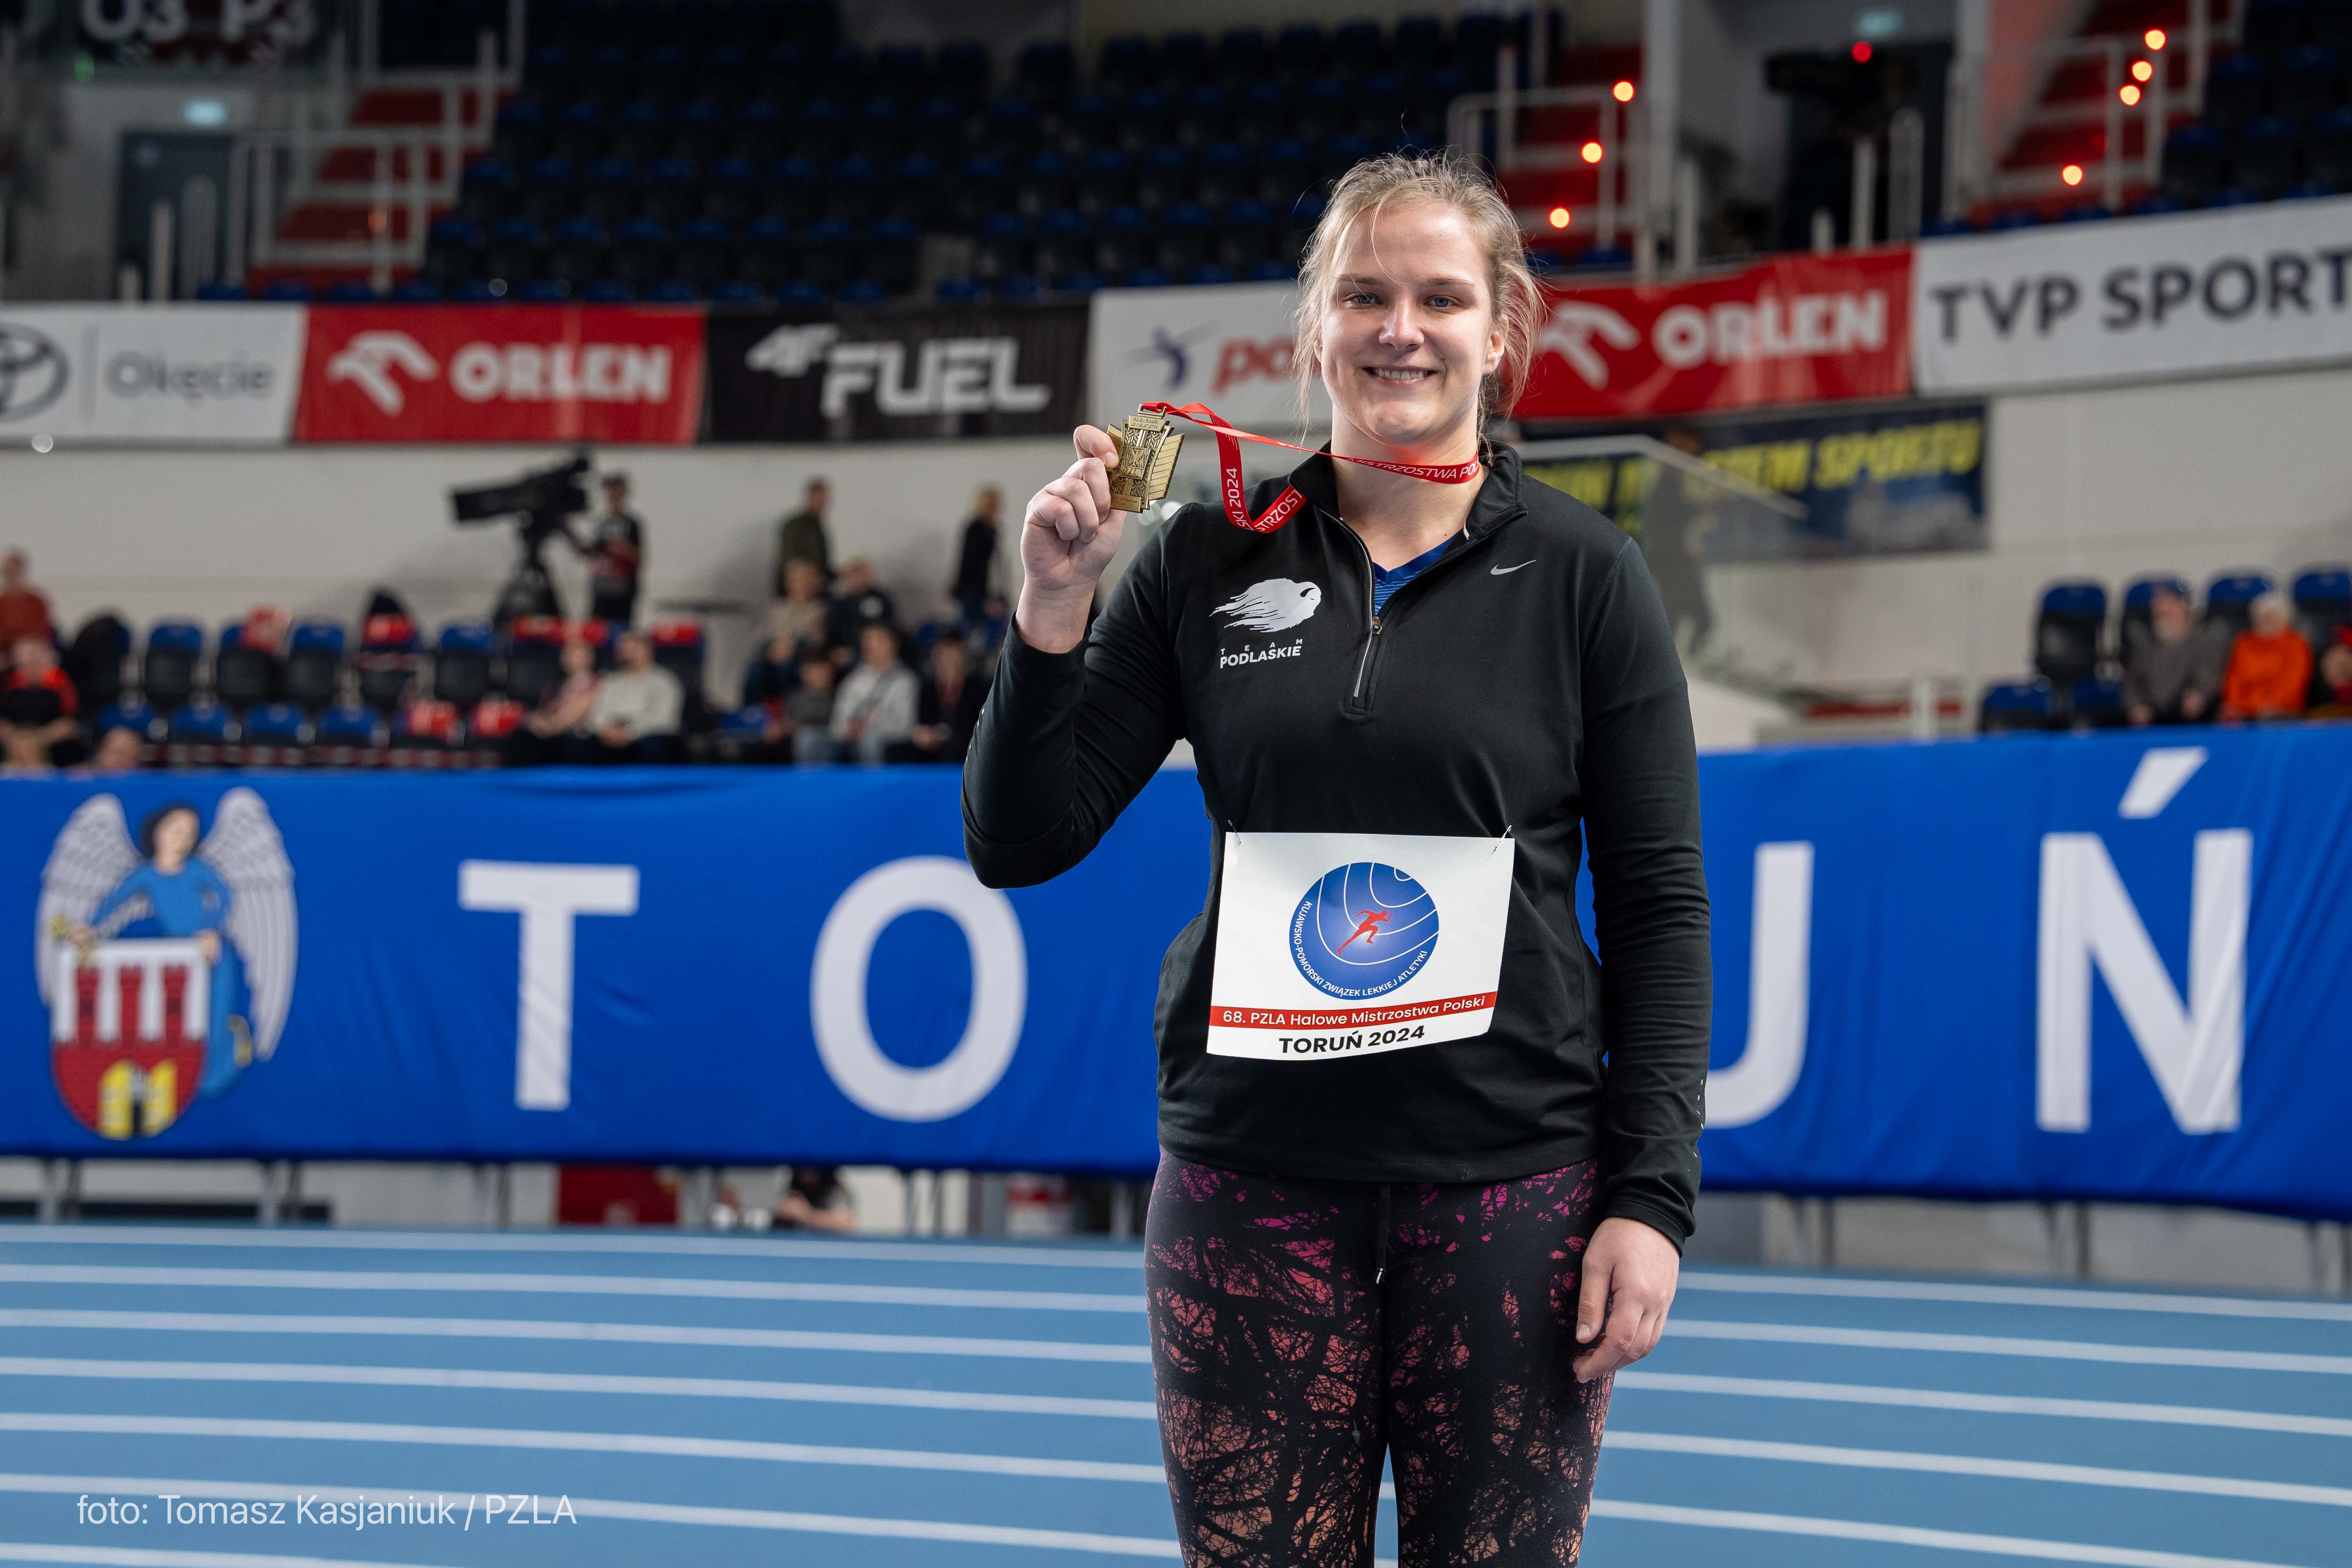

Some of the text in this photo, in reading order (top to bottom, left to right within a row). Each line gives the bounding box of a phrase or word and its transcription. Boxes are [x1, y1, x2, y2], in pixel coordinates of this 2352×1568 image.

[1931, 245, 2352, 342] TVP SPORT
[1652, 289, 1889, 370] ORLEN
[449, 342, 671, 403] ORLEN
[820, 335, 1052, 419] FUEL
[1226, 467, 1241, 507] 2024
[1348, 458, 1479, 478] MISTRZOSTWA POL
[1220, 639, 1303, 655] TEAM
[1220, 646, 1302, 669] PODLASKIE
[1294, 901, 1428, 997] KUJAWSKO-POMORSKI ZWIĄZEK LEKKIEJ ATLETYKI
[1223, 995, 1485, 1026] 68. PZLA Halowe Mistrzostwa Polski
[1279, 1025, 1425, 1054] TORUŃ 2024
